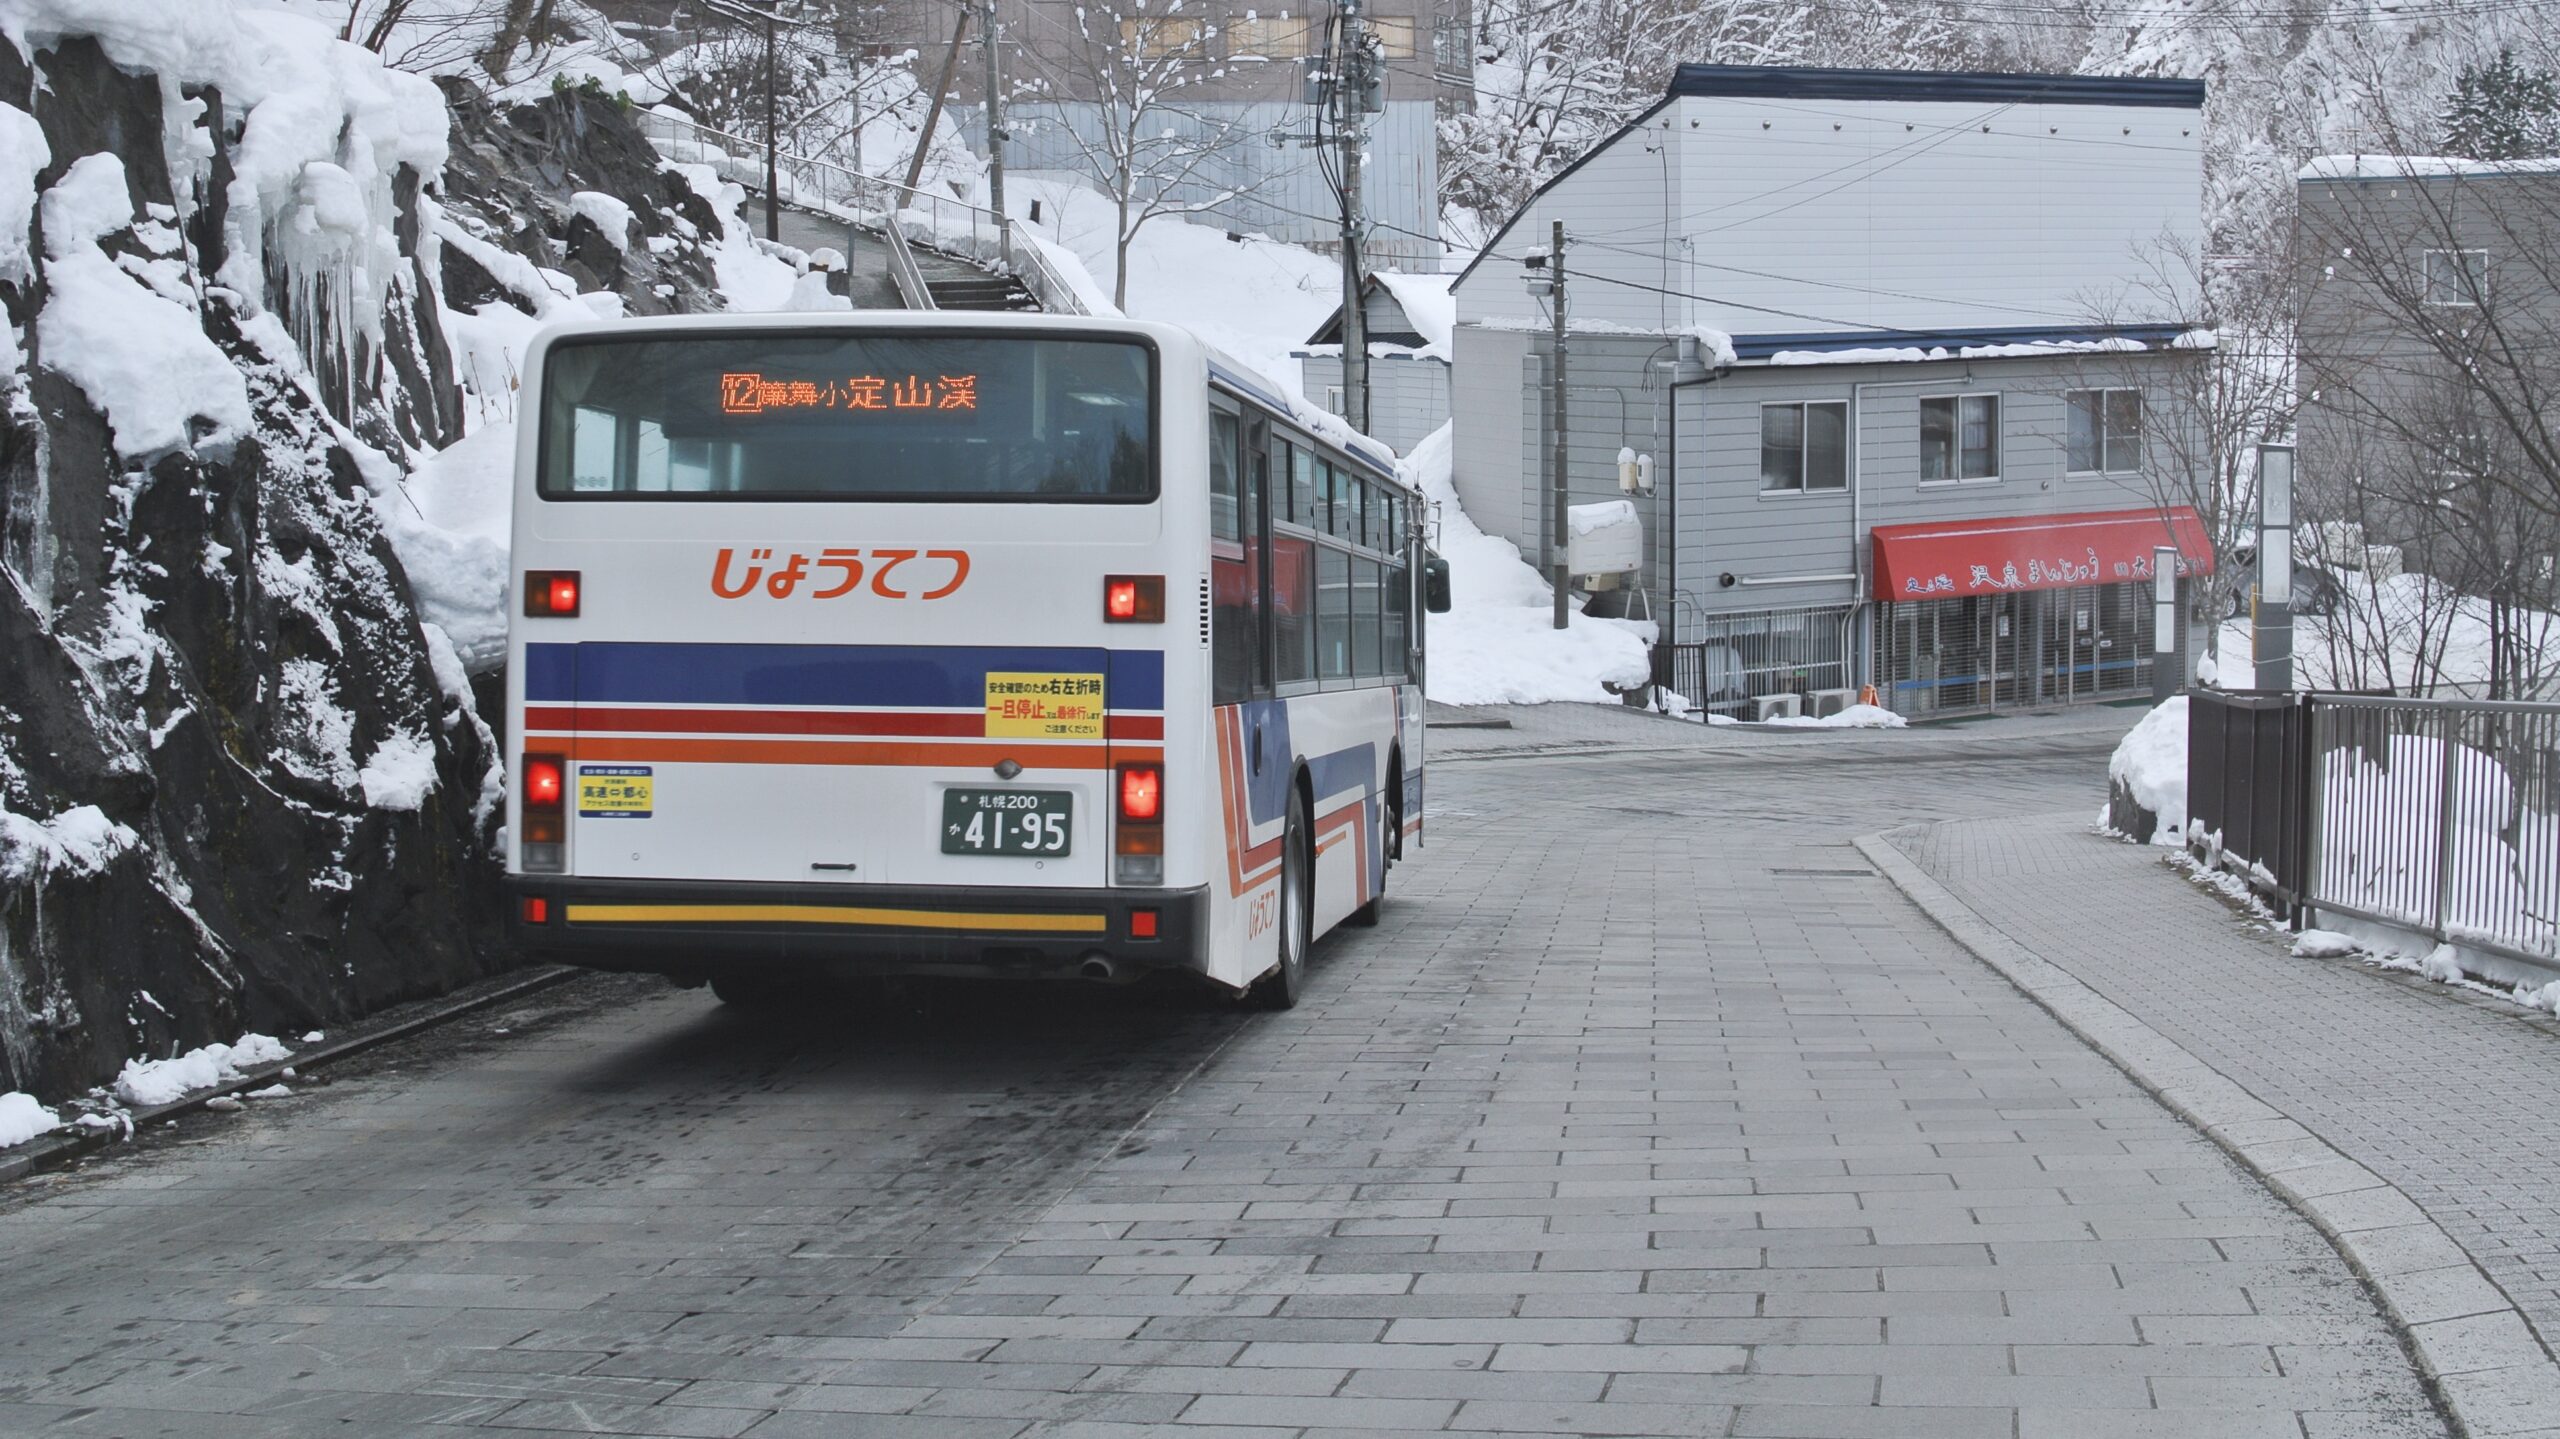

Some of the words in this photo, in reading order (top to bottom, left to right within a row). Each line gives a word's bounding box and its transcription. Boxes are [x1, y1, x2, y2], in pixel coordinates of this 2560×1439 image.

[711, 548, 970, 600] じょうてつ
[979, 795, 1006, 808] 札幌
[1006, 795, 1038, 809] 200
[949, 823, 961, 836] か
[965, 811, 1066, 851] 41-95
[1249, 889, 1275, 941] じょうてつ
